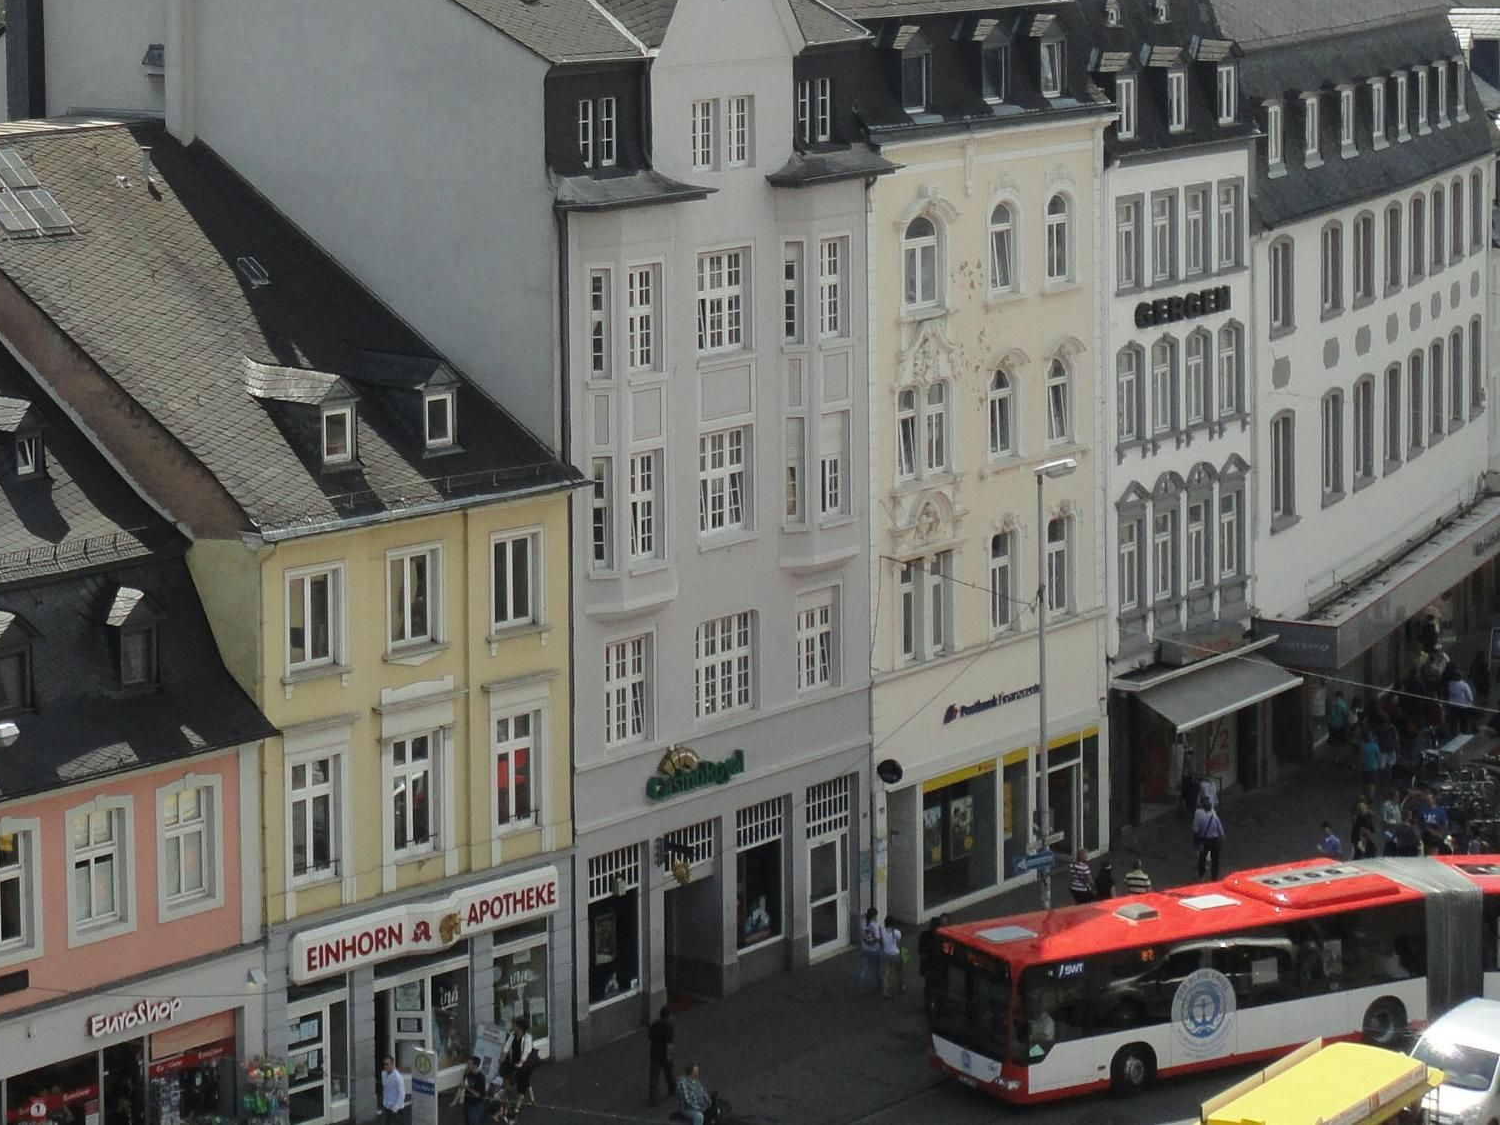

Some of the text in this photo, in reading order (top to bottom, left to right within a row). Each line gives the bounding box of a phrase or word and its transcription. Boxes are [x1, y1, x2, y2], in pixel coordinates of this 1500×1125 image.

[1134, 285, 1231, 329] GERGEN
[960, 694, 997, 717] Postbank
[306, 922, 404, 972] EINHORN
[466, 881, 556, 926] APOTHEKE
